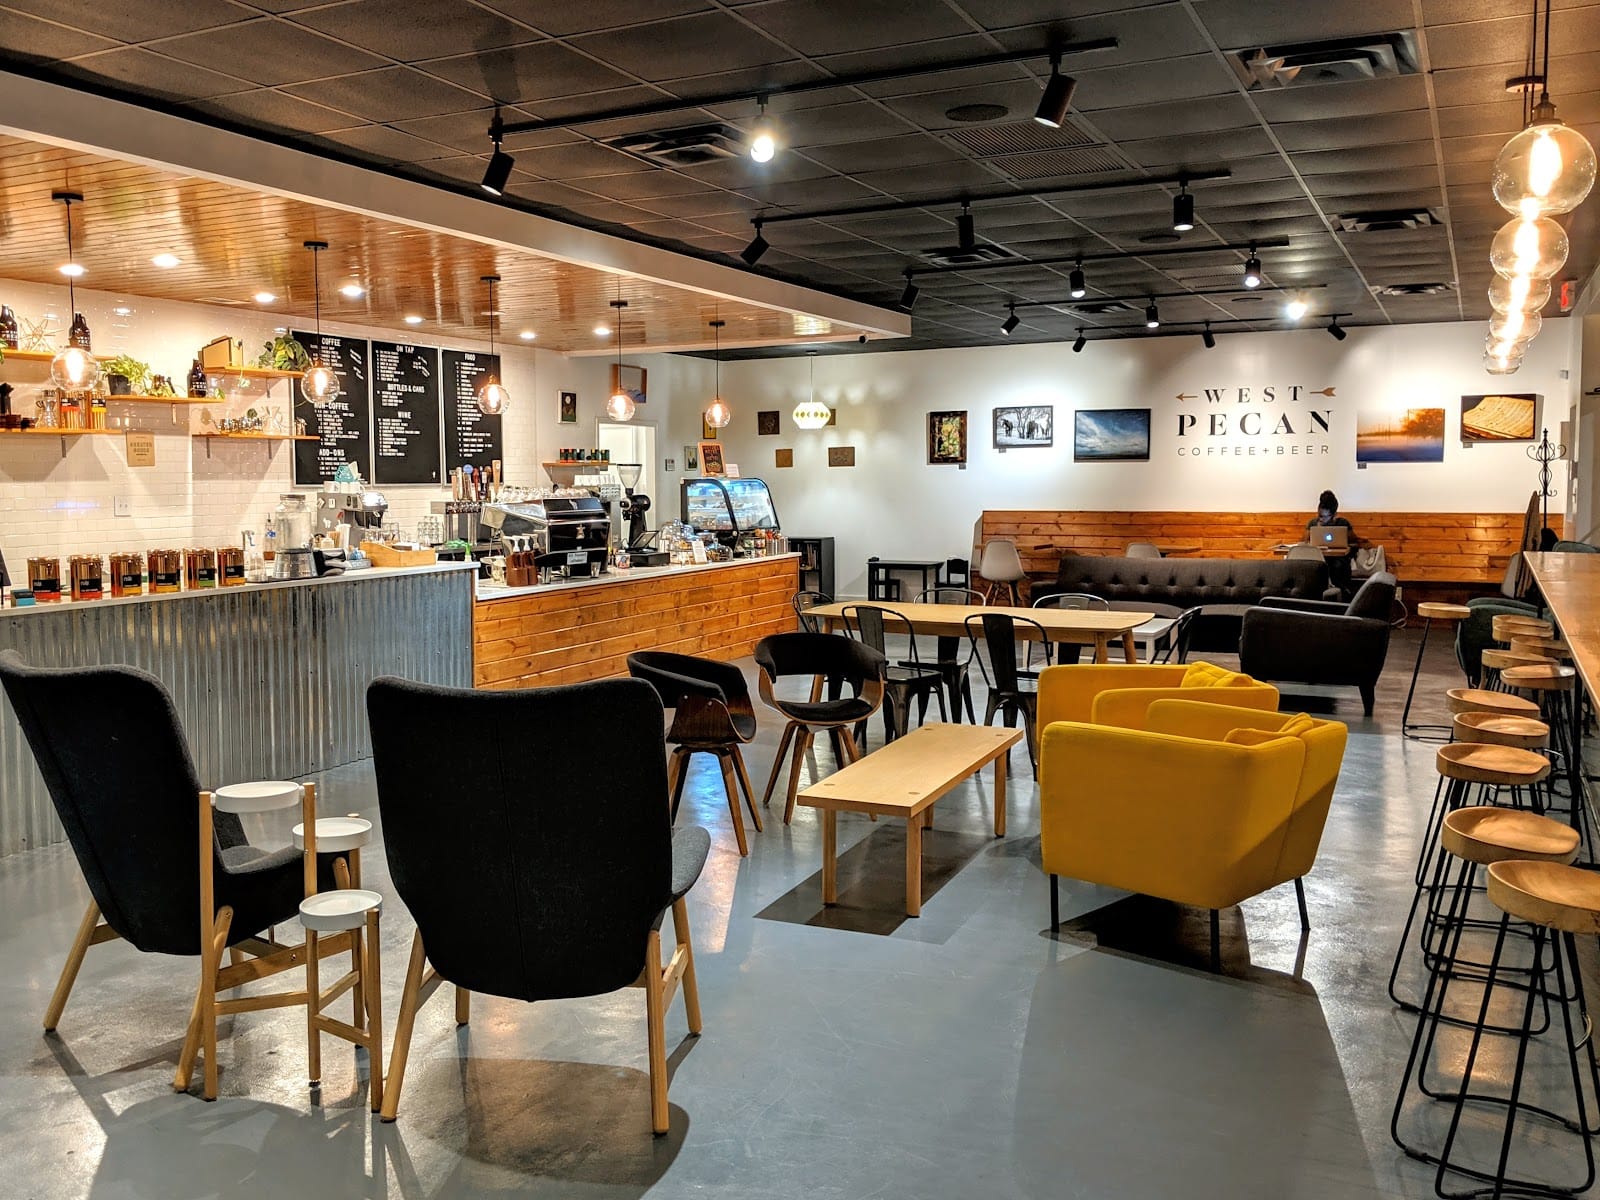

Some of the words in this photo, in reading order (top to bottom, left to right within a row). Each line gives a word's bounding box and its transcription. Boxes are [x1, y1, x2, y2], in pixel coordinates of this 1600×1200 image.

[321, 337, 341, 347] COFFEE
[396, 344, 404, 353] ON
[404, 345, 415, 354] TAP
[412, 385, 425, 394] CANS
[1203, 385, 1303, 404] WEST
[397, 411, 412, 420] WINE
[1176, 409, 1334, 437] PECAN
[1177, 445, 1329, 457] COFFEE+BEER
